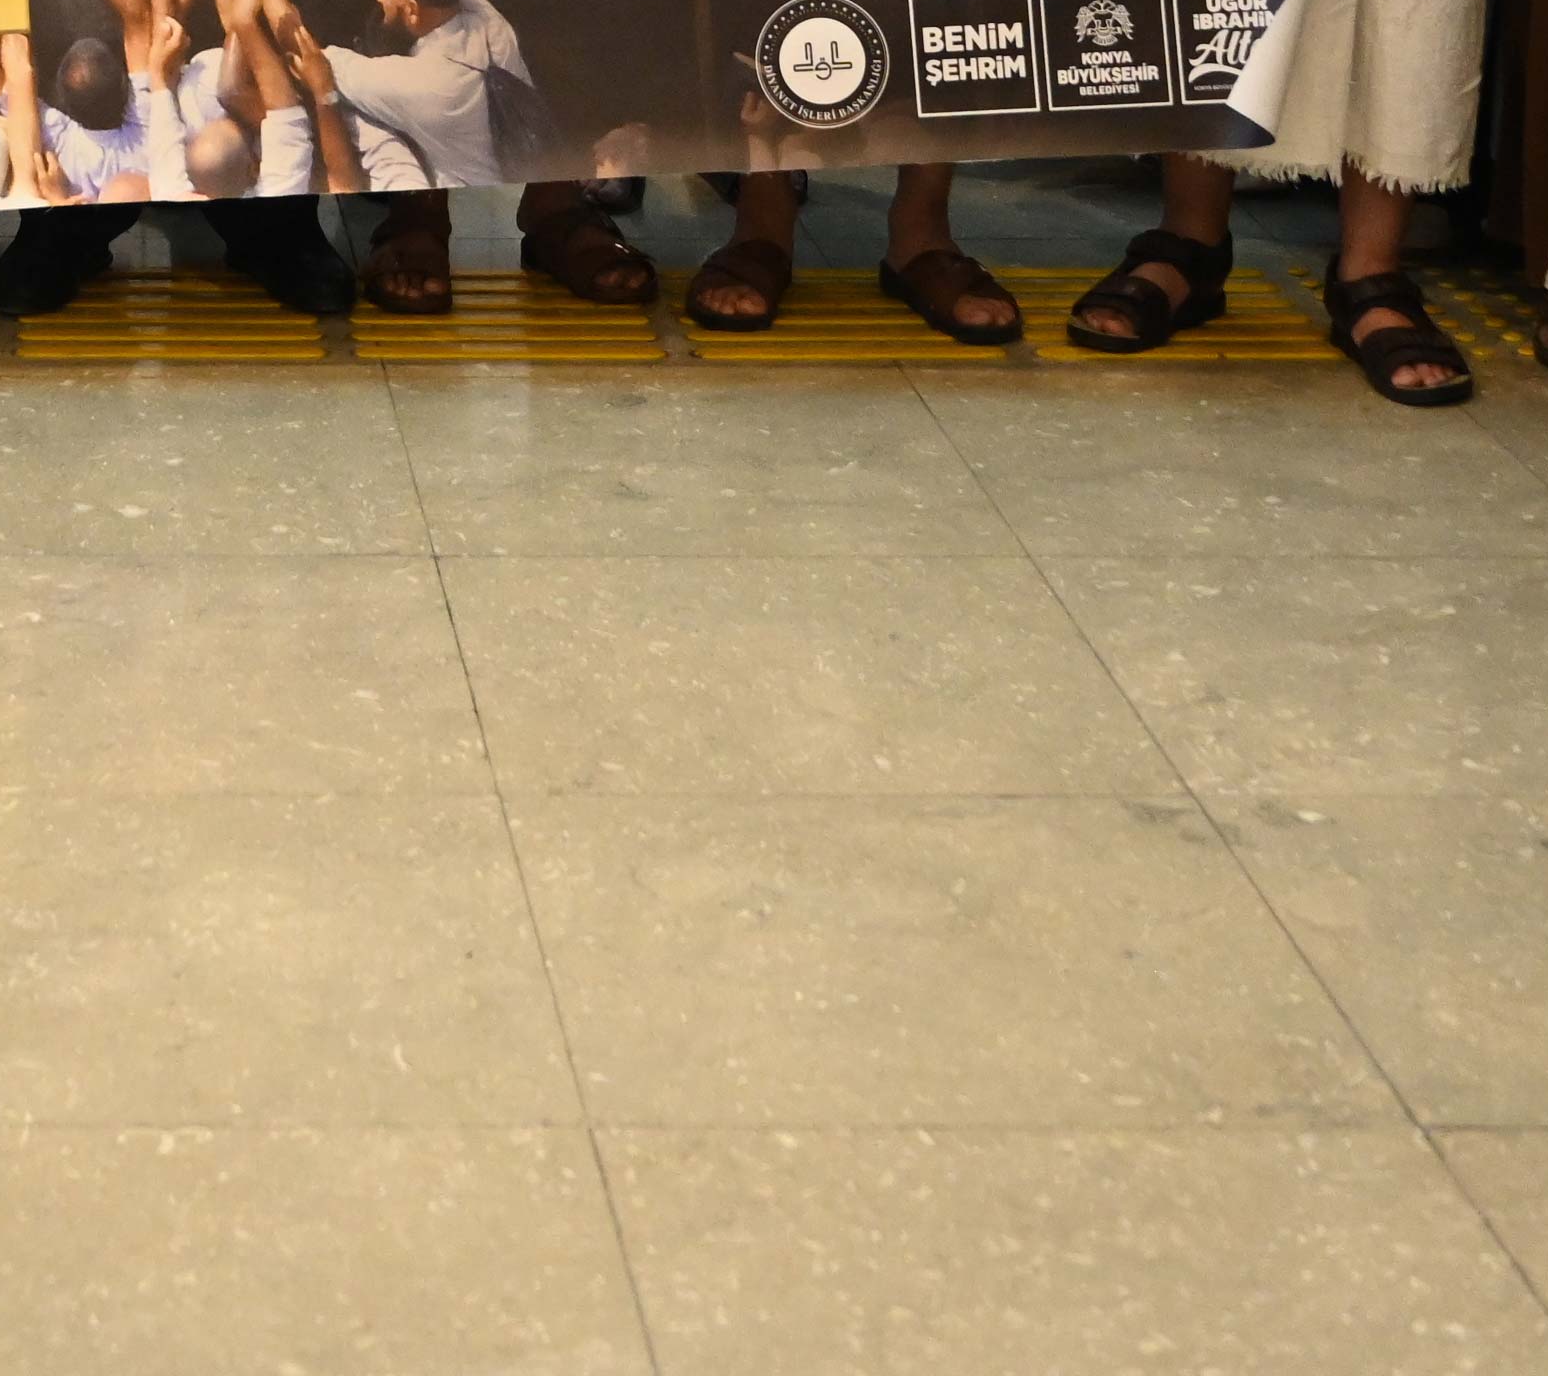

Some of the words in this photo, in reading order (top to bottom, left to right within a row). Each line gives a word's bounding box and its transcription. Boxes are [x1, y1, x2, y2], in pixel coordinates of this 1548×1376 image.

[1080, 50, 1133, 65] KONYA
[1188, 29, 1252, 84] Alt
[1057, 62, 1160, 86] BÜYÜKŞEHİR
[764, 64, 798, 111] DİYANET
[797, 106, 838, 121] İŞLERİ
[838, 59, 883, 119] BAŞKANLIĞI
[1079, 81, 1141, 96] BELEDİYESİ
